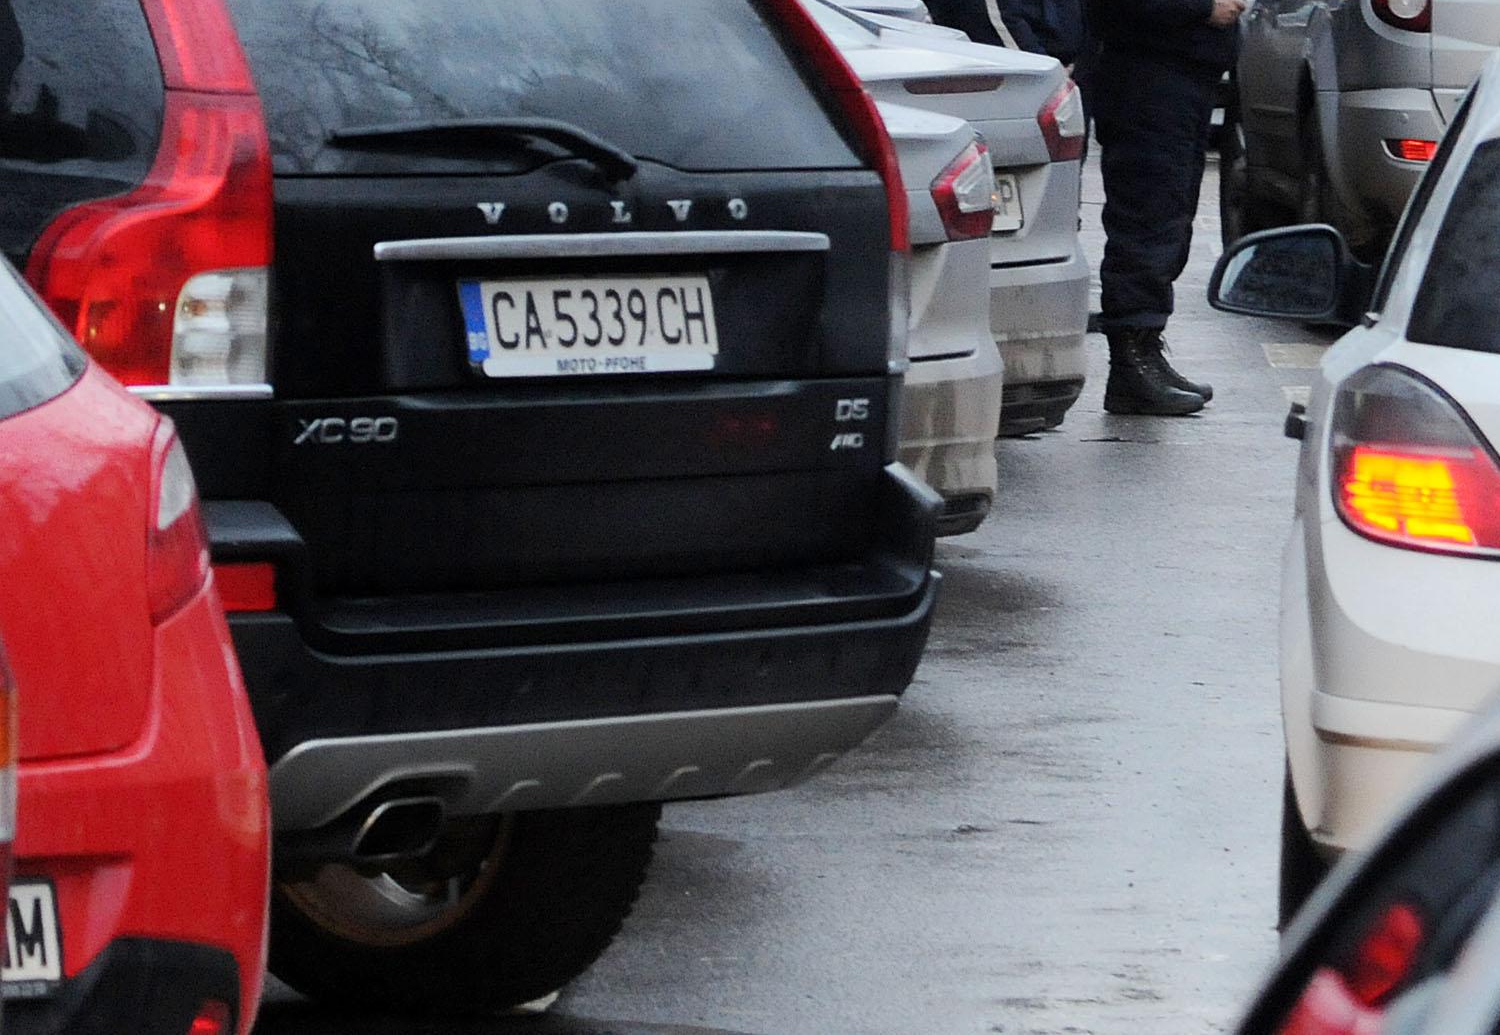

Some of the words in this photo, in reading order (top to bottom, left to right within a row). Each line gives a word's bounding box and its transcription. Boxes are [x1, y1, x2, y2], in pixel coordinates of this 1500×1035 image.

[477, 198, 748, 224] VOLVO
[835, 399, 869, 421] D5
[294, 417, 398, 444] XC90
